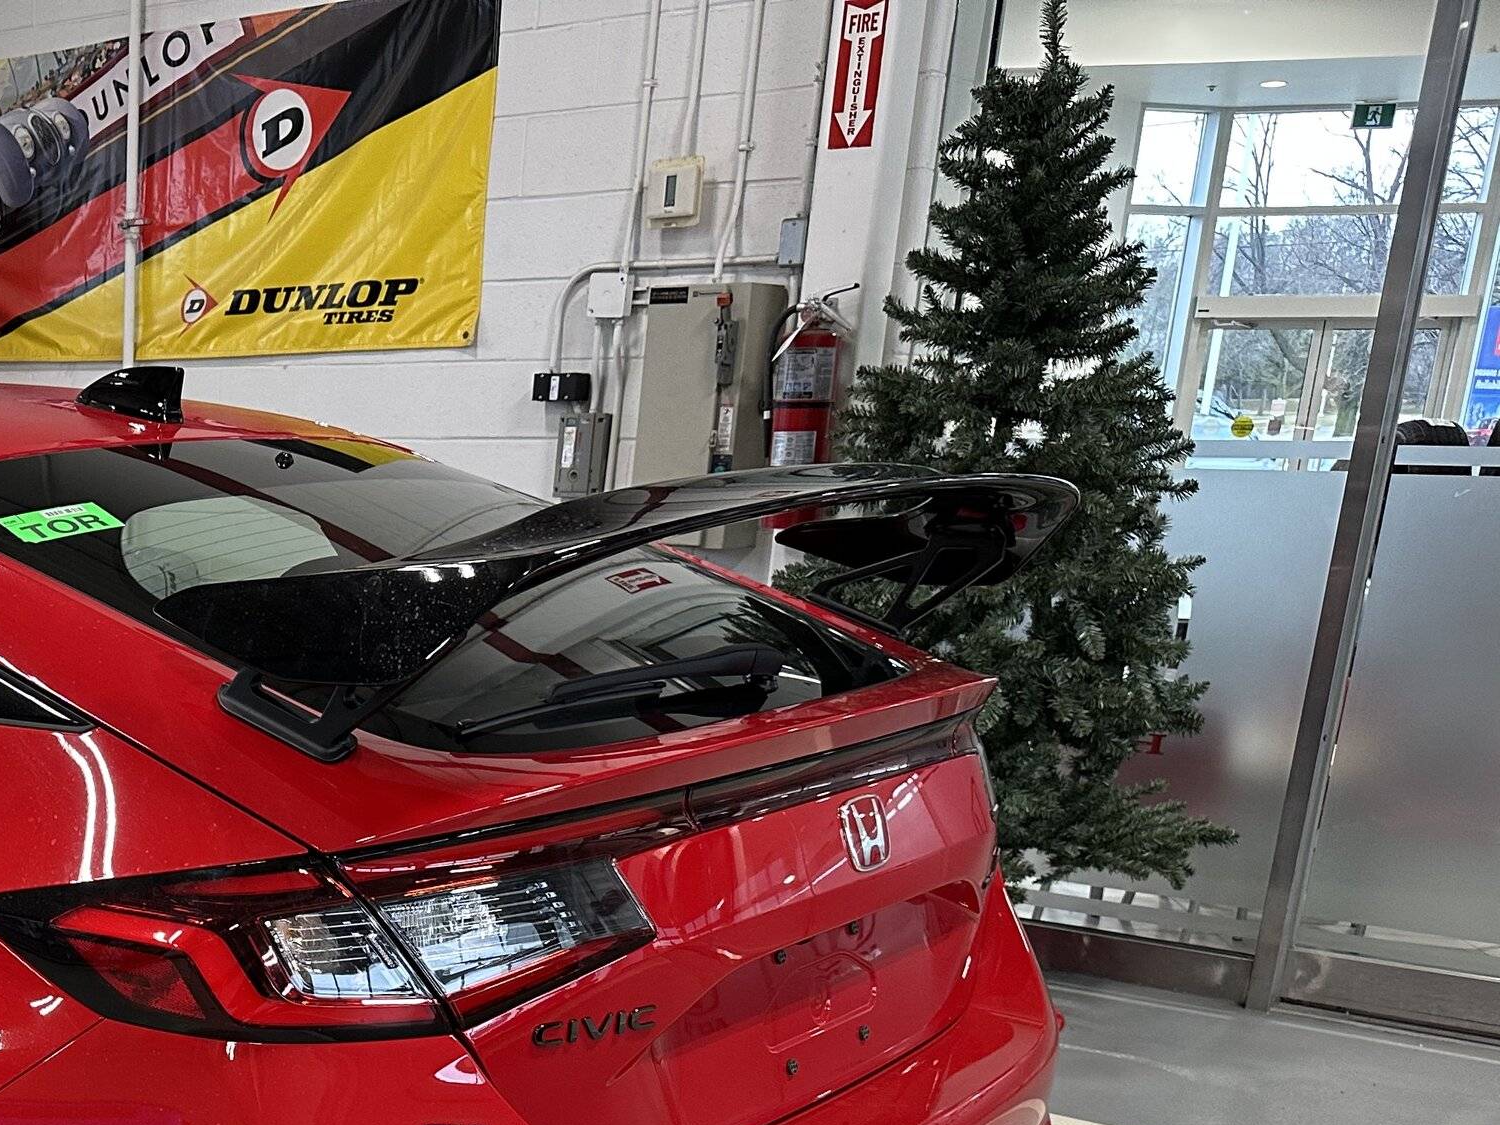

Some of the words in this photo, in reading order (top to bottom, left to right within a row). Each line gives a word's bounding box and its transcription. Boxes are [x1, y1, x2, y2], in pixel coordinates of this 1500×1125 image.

[848, 12, 880, 34] FIRE
[78, 22, 216, 126] UNLO
[846, 36, 866, 136] EXTINGUISHER
[261, 106, 305, 159] D
[224, 278, 419, 316] DUNLOP
[323, 309, 395, 325] TIRES
[19, 514, 110, 539] TOR
[531, 1003, 658, 1047] CIVIC
